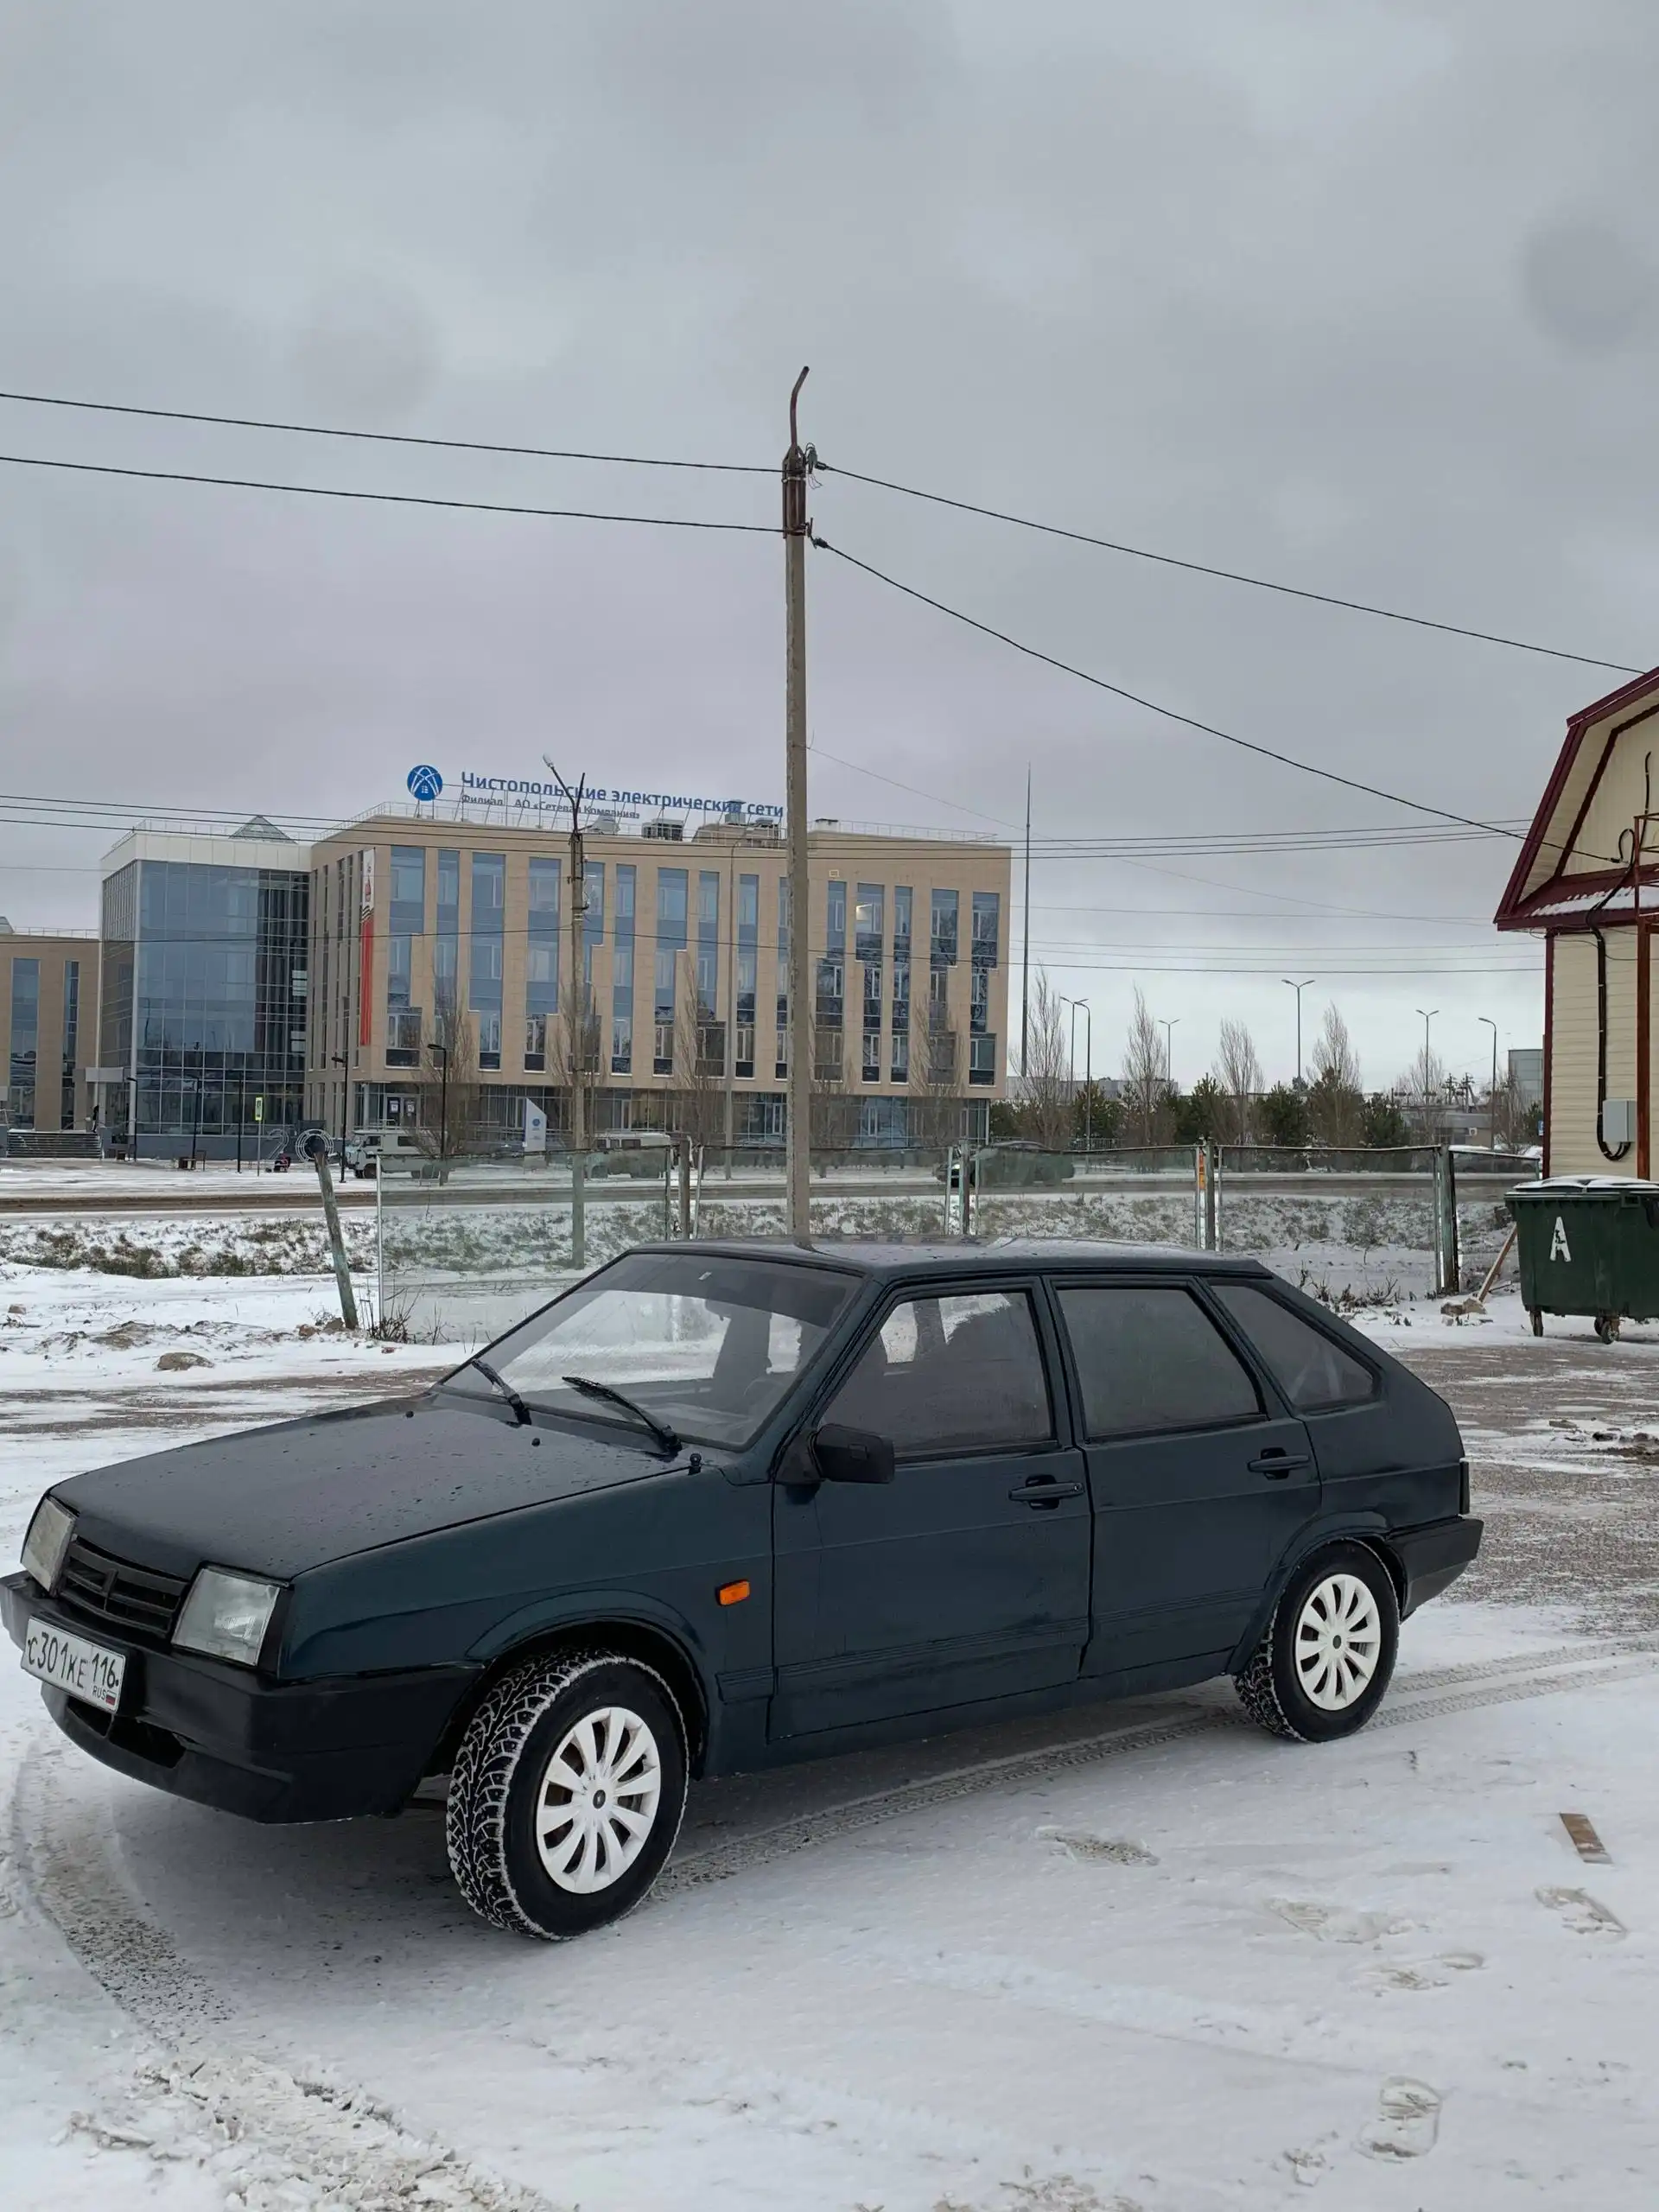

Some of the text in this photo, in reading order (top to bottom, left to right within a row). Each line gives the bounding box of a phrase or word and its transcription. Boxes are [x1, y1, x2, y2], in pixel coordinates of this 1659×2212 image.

[461, 770, 607, 800] Чистопольские
[747, 803, 784, 817] сети
[92, 1685, 106, 1700] RUS
